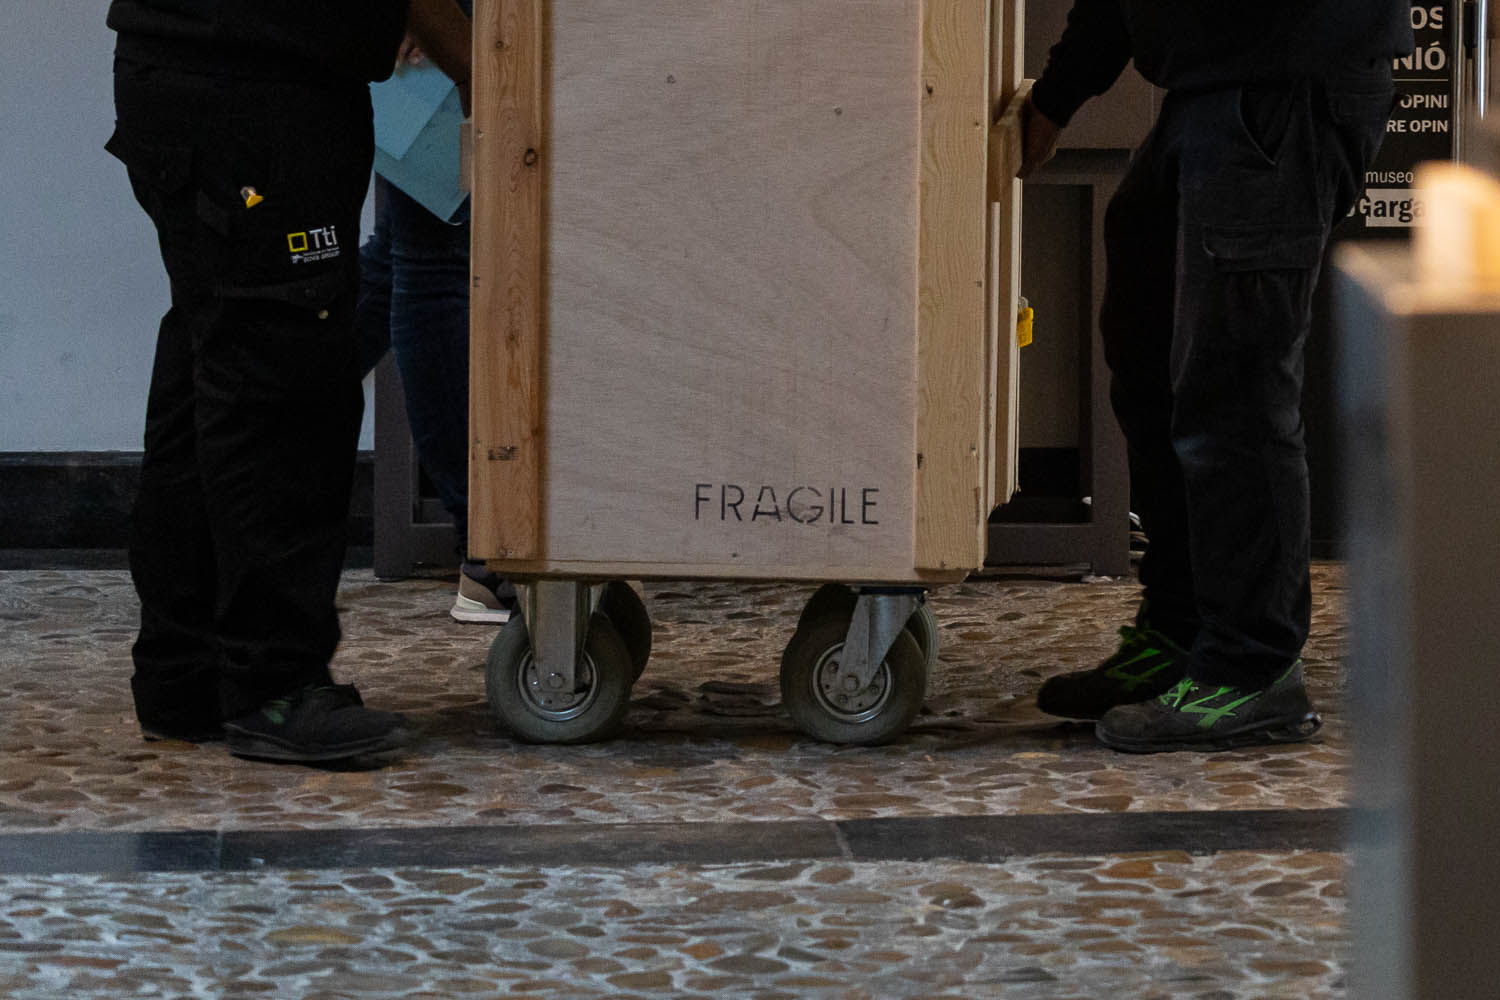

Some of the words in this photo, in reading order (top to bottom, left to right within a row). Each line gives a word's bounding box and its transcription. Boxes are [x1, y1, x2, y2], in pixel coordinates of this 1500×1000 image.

[1386, 119, 1407, 132] RE
[1409, 119, 1448, 133] OPIN
[1365, 170, 1414, 183] museo
[309, 225, 338, 249] Tti
[695, 483, 880, 525] FRAGILE
